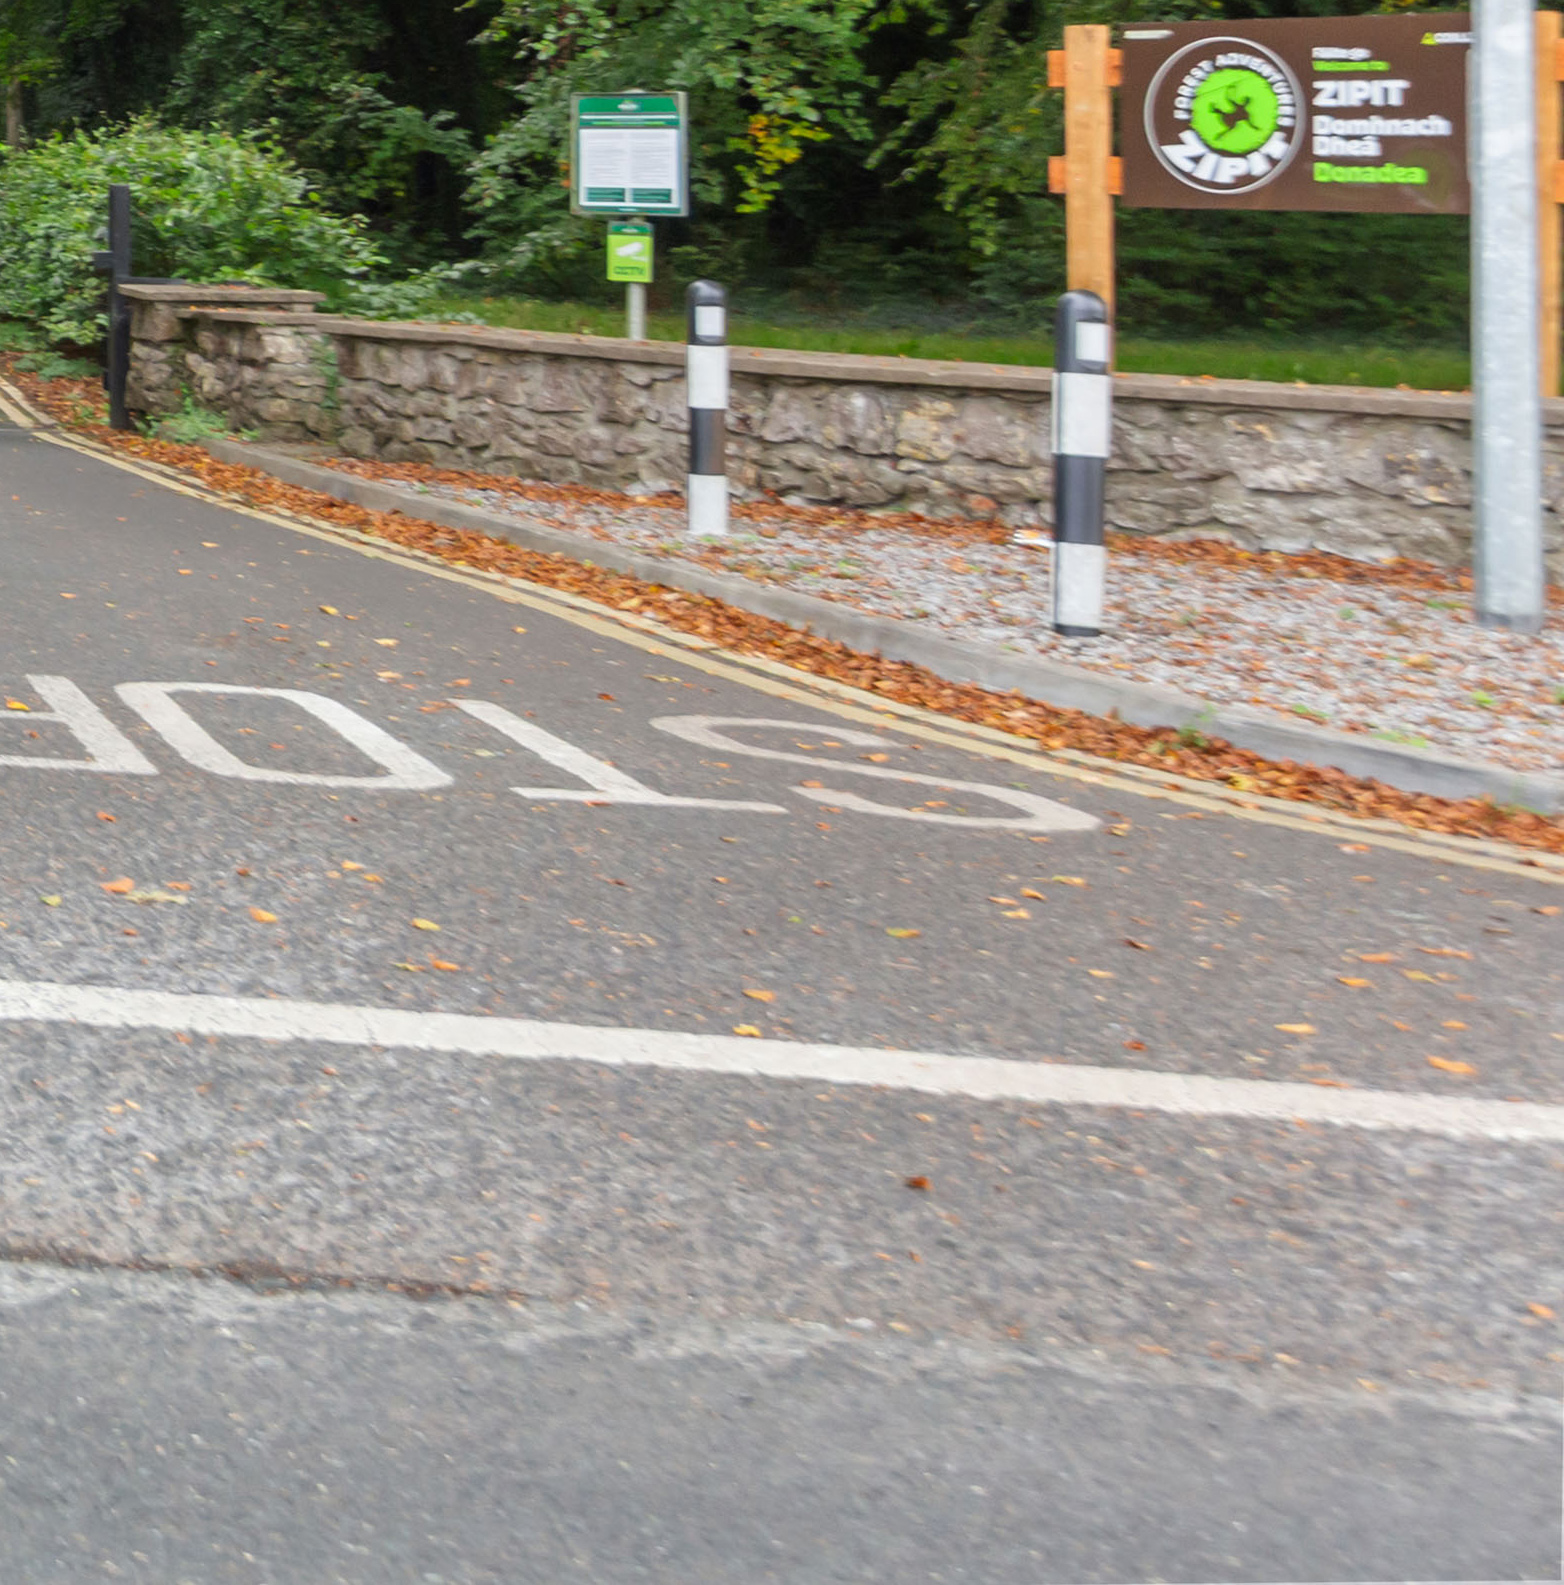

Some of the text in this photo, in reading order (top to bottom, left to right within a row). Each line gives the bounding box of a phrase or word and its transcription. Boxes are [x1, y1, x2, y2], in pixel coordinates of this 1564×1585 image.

[1173, 52, 1296, 128] FOREST ADVENTURES
[1311, 79, 1412, 107] ZIPIT
[1312, 115, 1453, 136] Domhnach
[1160, 129, 1291, 184] ZIPIT
[1312, 161, 1429, 185] Donadea
